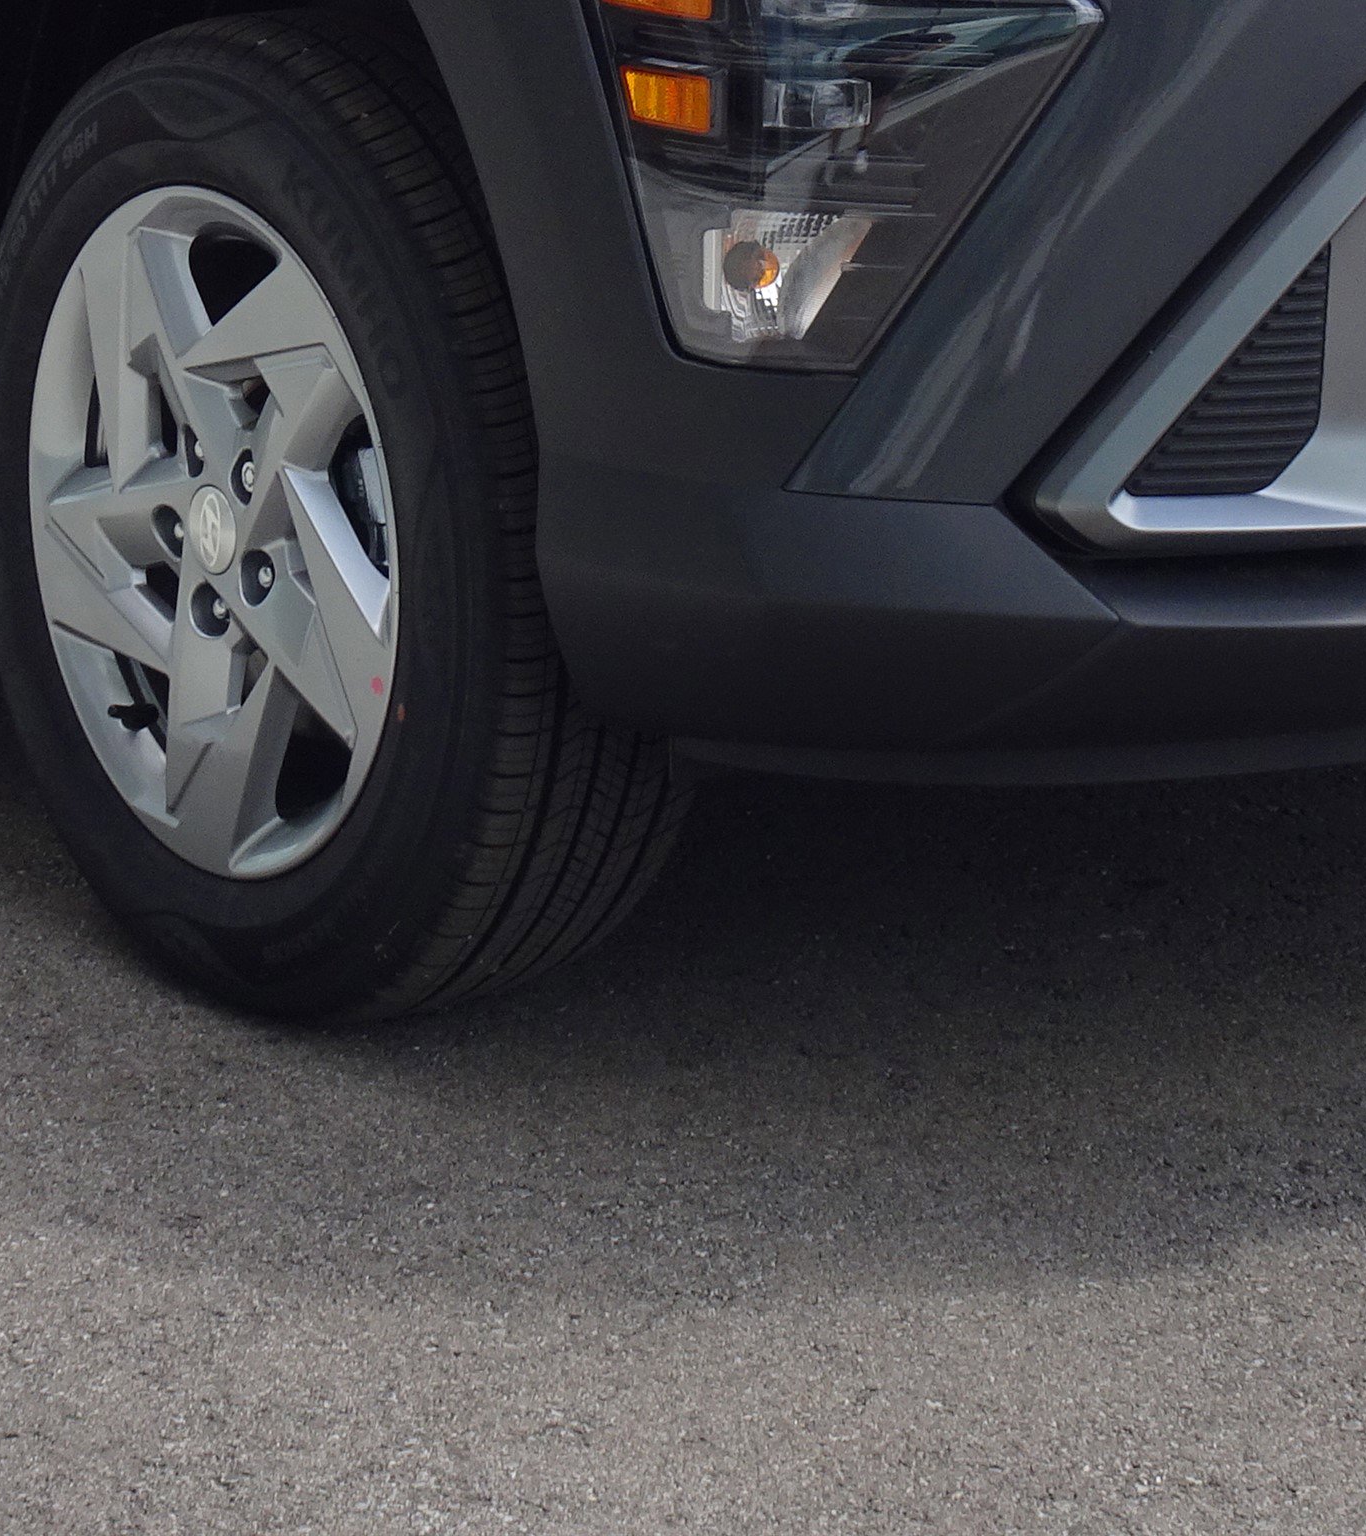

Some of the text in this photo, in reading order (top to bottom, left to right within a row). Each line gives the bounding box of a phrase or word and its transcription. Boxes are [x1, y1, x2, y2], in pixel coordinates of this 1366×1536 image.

[28, 160, 58, 218] R17
[63, 121, 98, 170] 96H
[281, 161, 409, 400] KUMHO
